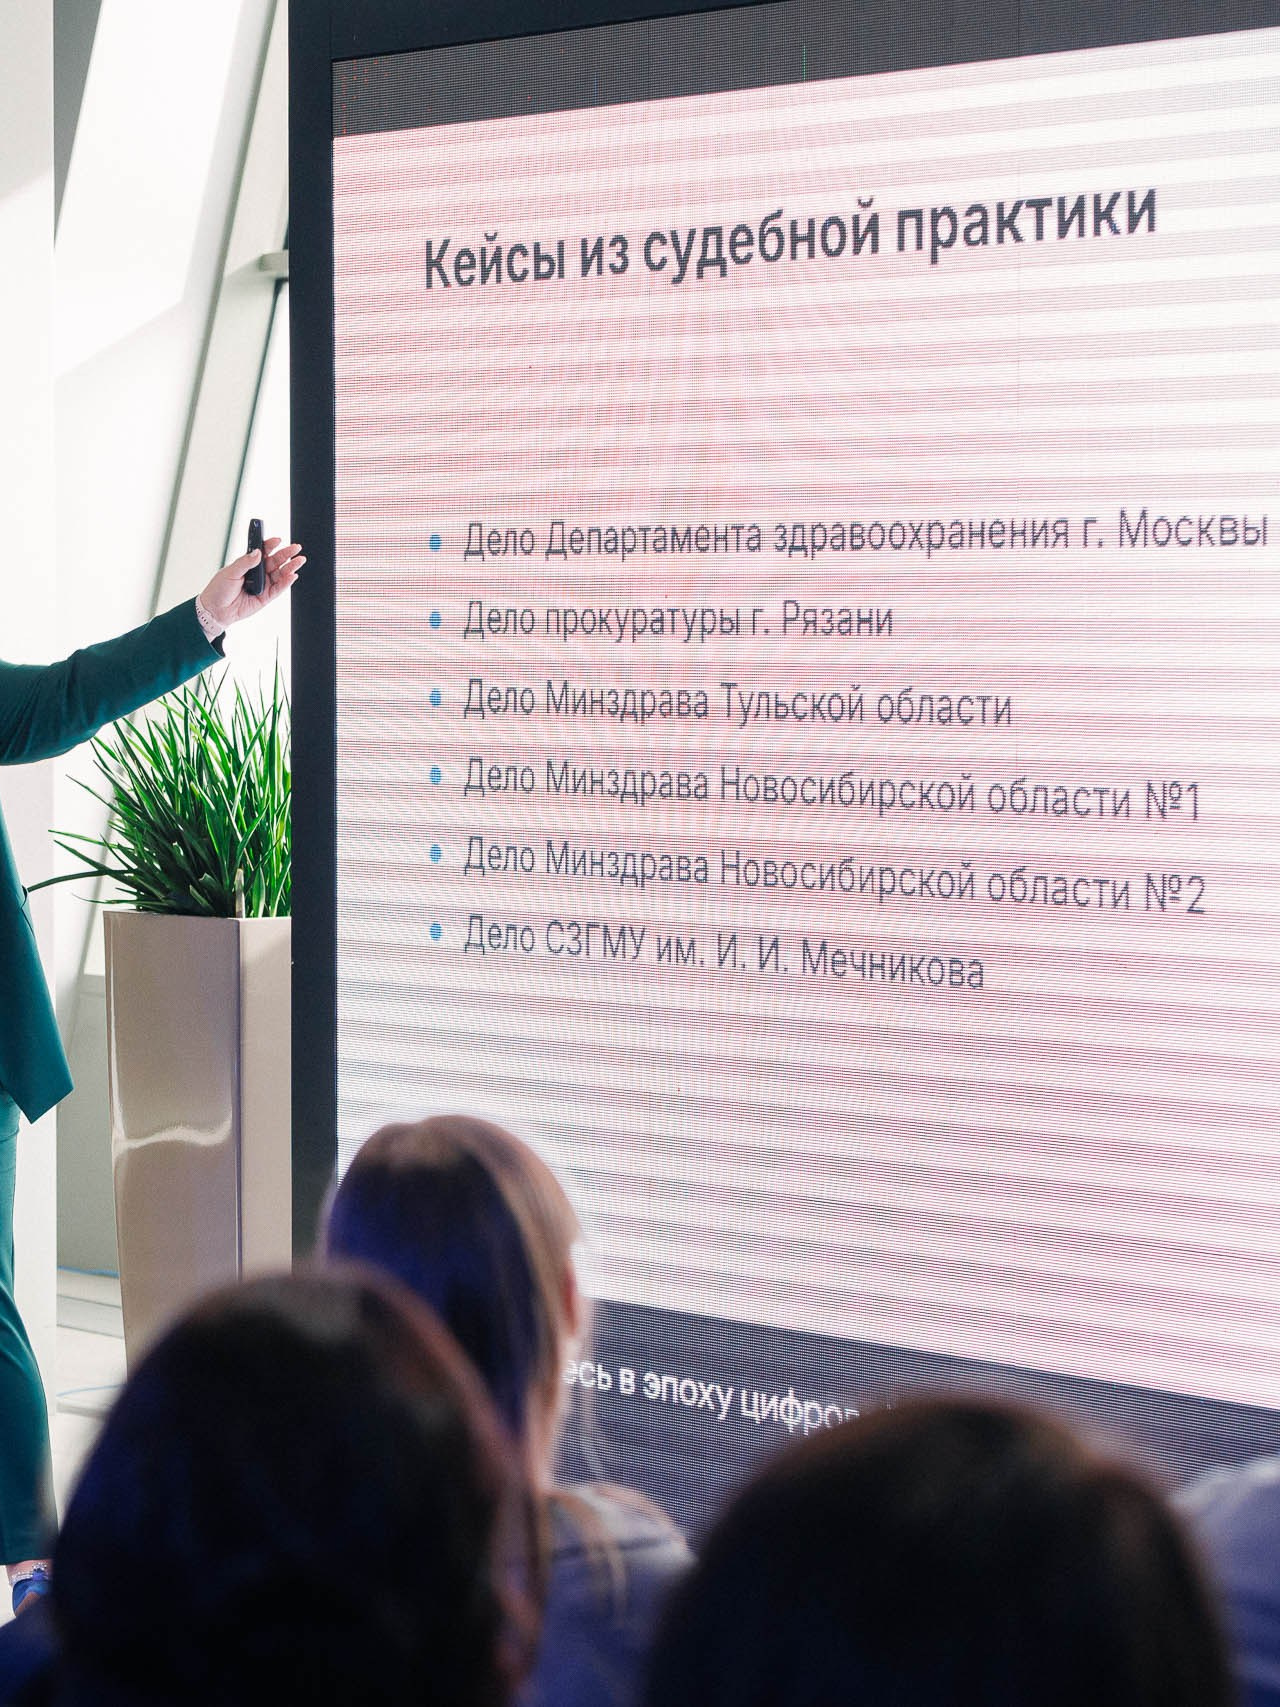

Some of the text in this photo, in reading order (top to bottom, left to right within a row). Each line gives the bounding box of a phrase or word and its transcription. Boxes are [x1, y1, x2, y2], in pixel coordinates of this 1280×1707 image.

[425, 188, 1157, 290] Кейсы из судебной практики
[463, 507, 1269, 562] Дело Департамента здравоохранения г. Москвы
[463, 600, 893, 643] Дело прокуратуры г. Рязани
[463, 678, 1012, 729] Дело Минздрава Тульской области
[464, 756, 1200, 821] Дело Минздрава Новосибирской области №1
[464, 836, 1208, 914] Дело Минздрава Новосибирской области №2
[464, 914, 984, 989] Дело СЗГМУ им. И. И. Мечникова
[619, 1368, 636, 1395] в
[643, 1372, 735, 1421] эпоху
